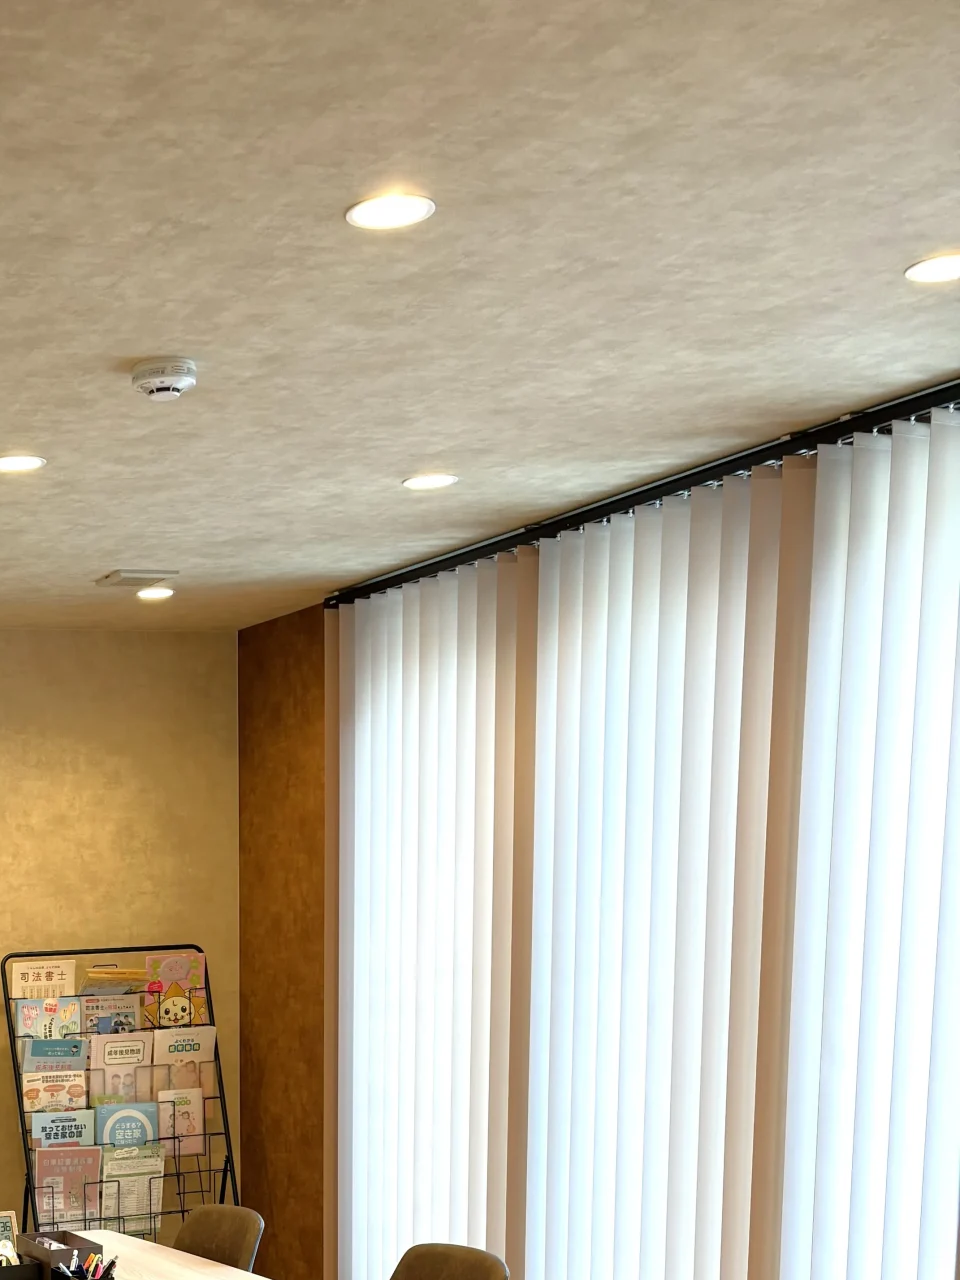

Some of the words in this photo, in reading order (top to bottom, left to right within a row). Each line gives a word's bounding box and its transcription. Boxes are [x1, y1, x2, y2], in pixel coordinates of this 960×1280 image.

[20, 970, 67, 983] 司法書士
[41, 1123, 87, 1133] 放っておけない
